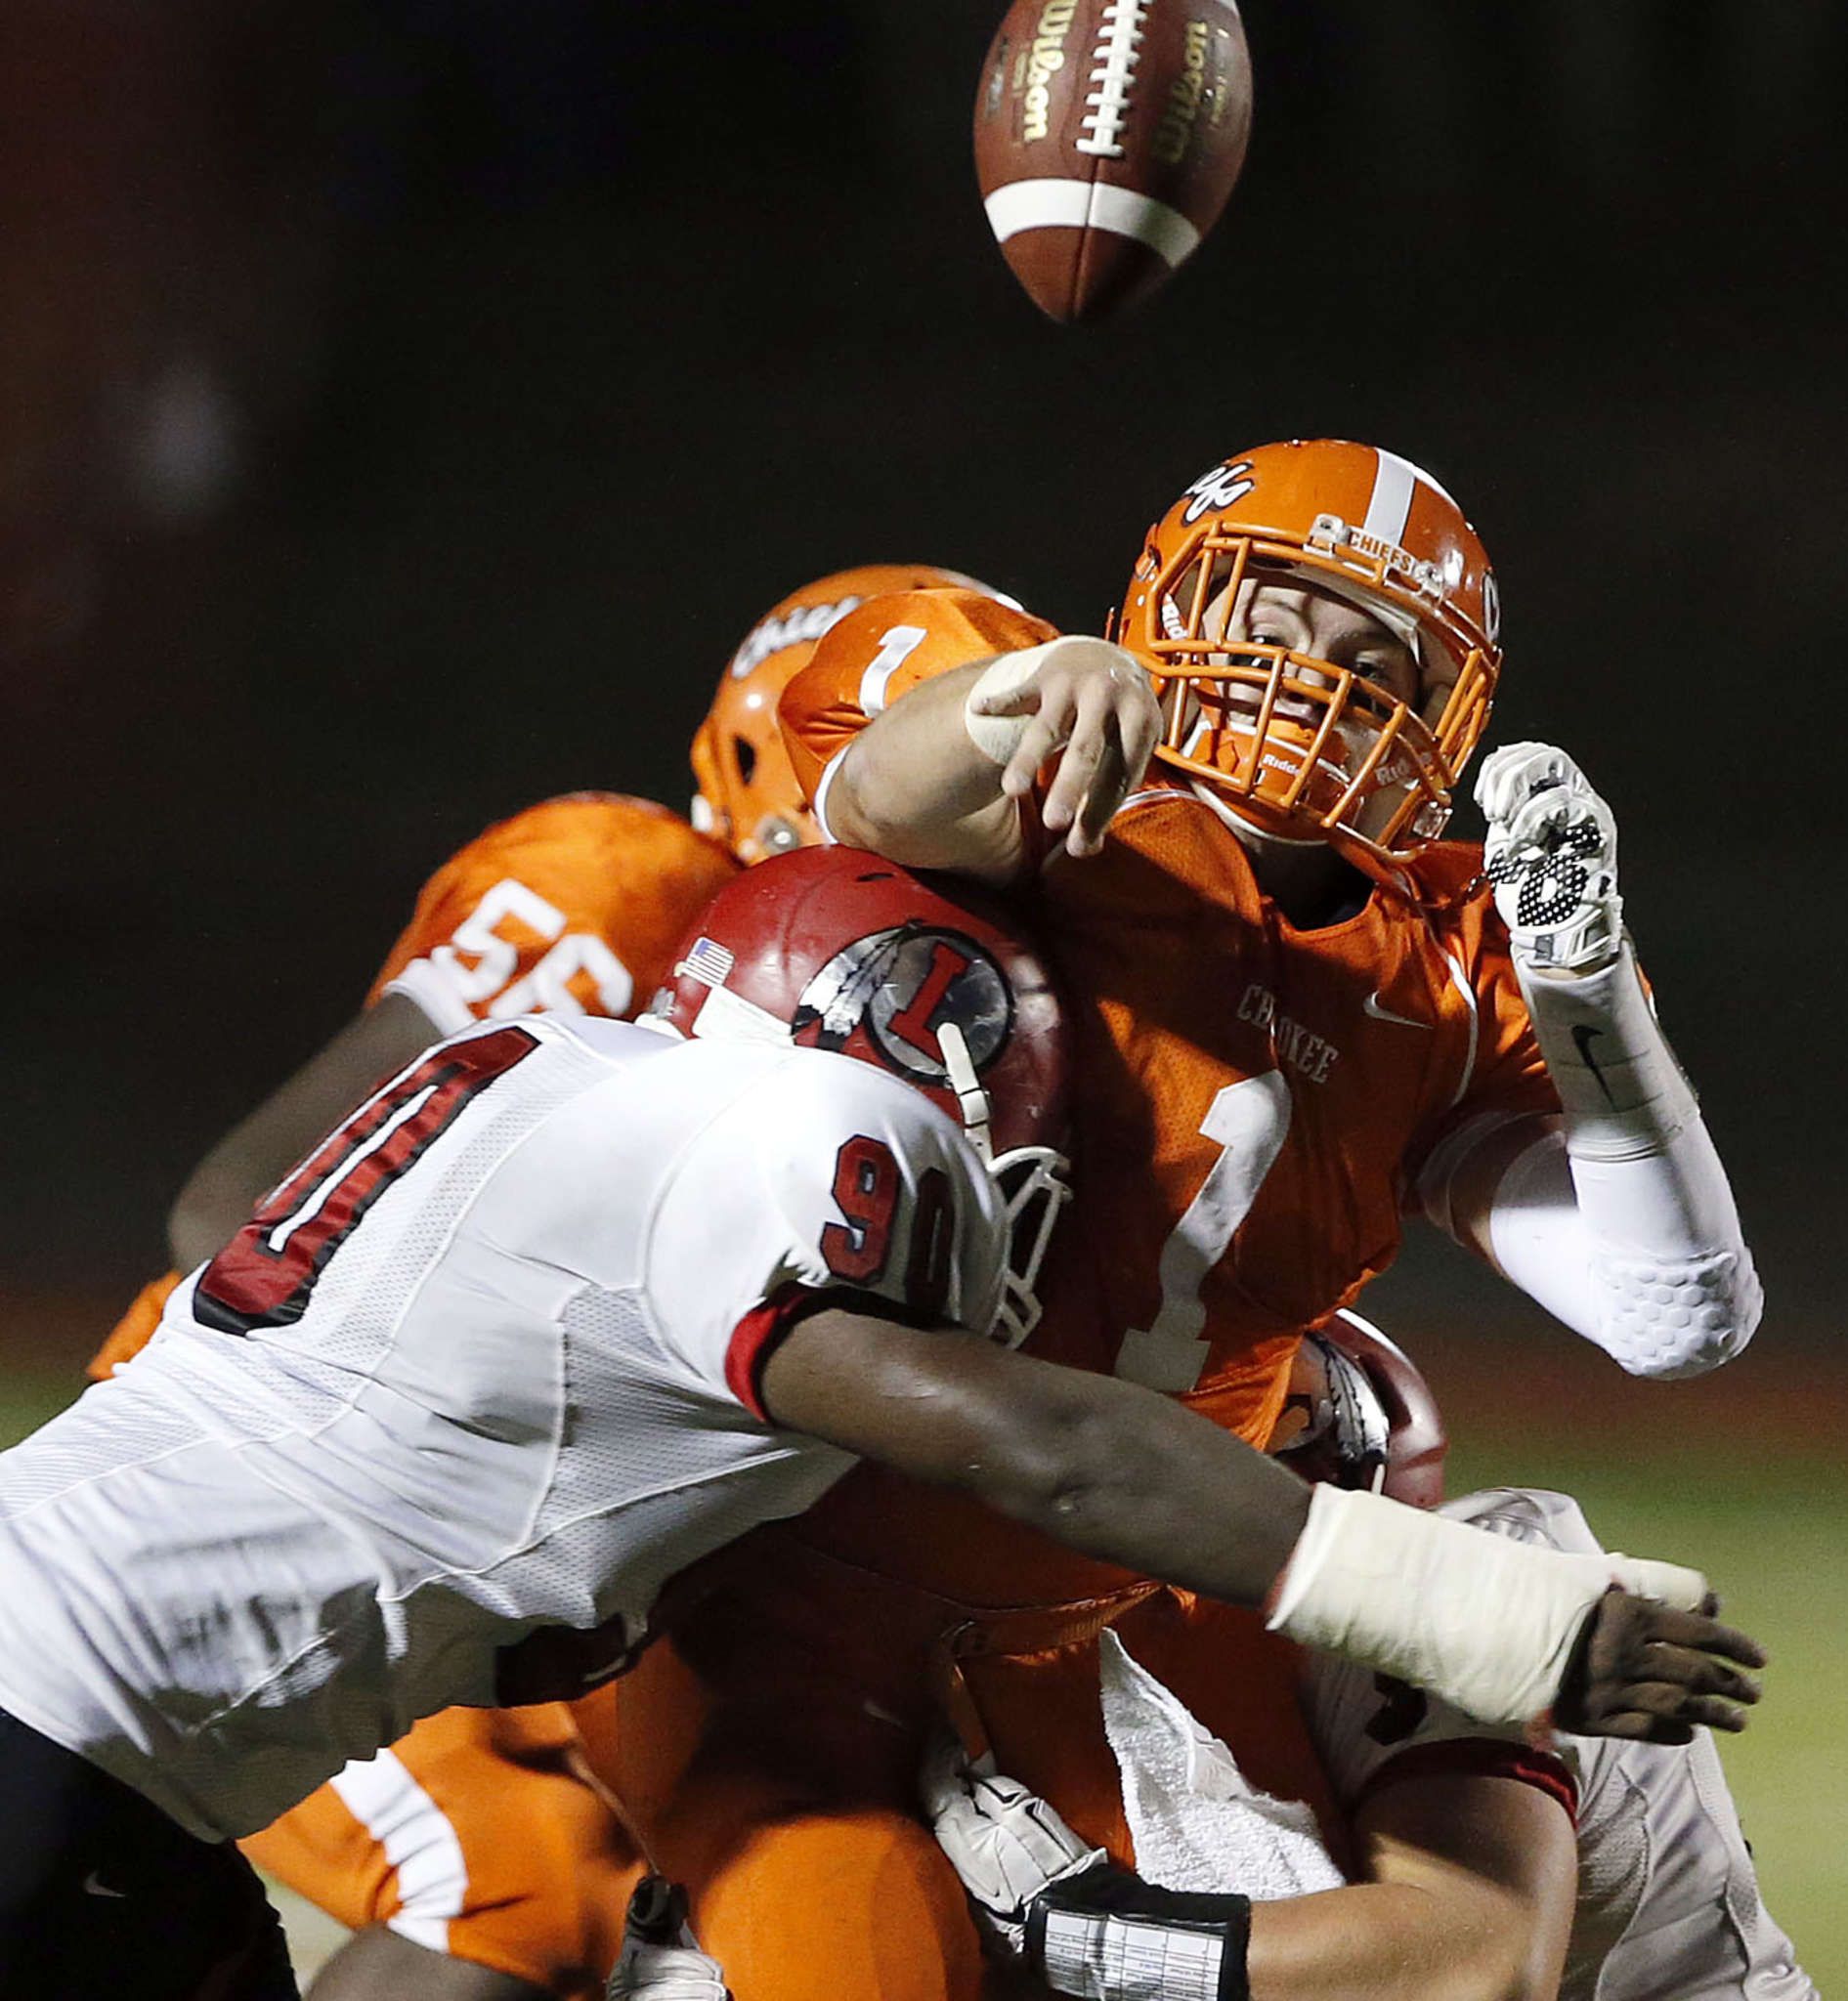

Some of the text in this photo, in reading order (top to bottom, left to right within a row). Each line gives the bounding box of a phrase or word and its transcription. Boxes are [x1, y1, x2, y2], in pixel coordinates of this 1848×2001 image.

[1349, 530, 1412, 573] CHIEFS
[1262, 753, 1303, 778] Ridd
[1235, 984, 1340, 1085] CHOKEE
[818, 1133, 956, 1311] 90
[1113, 1068, 1293, 1392] 1
